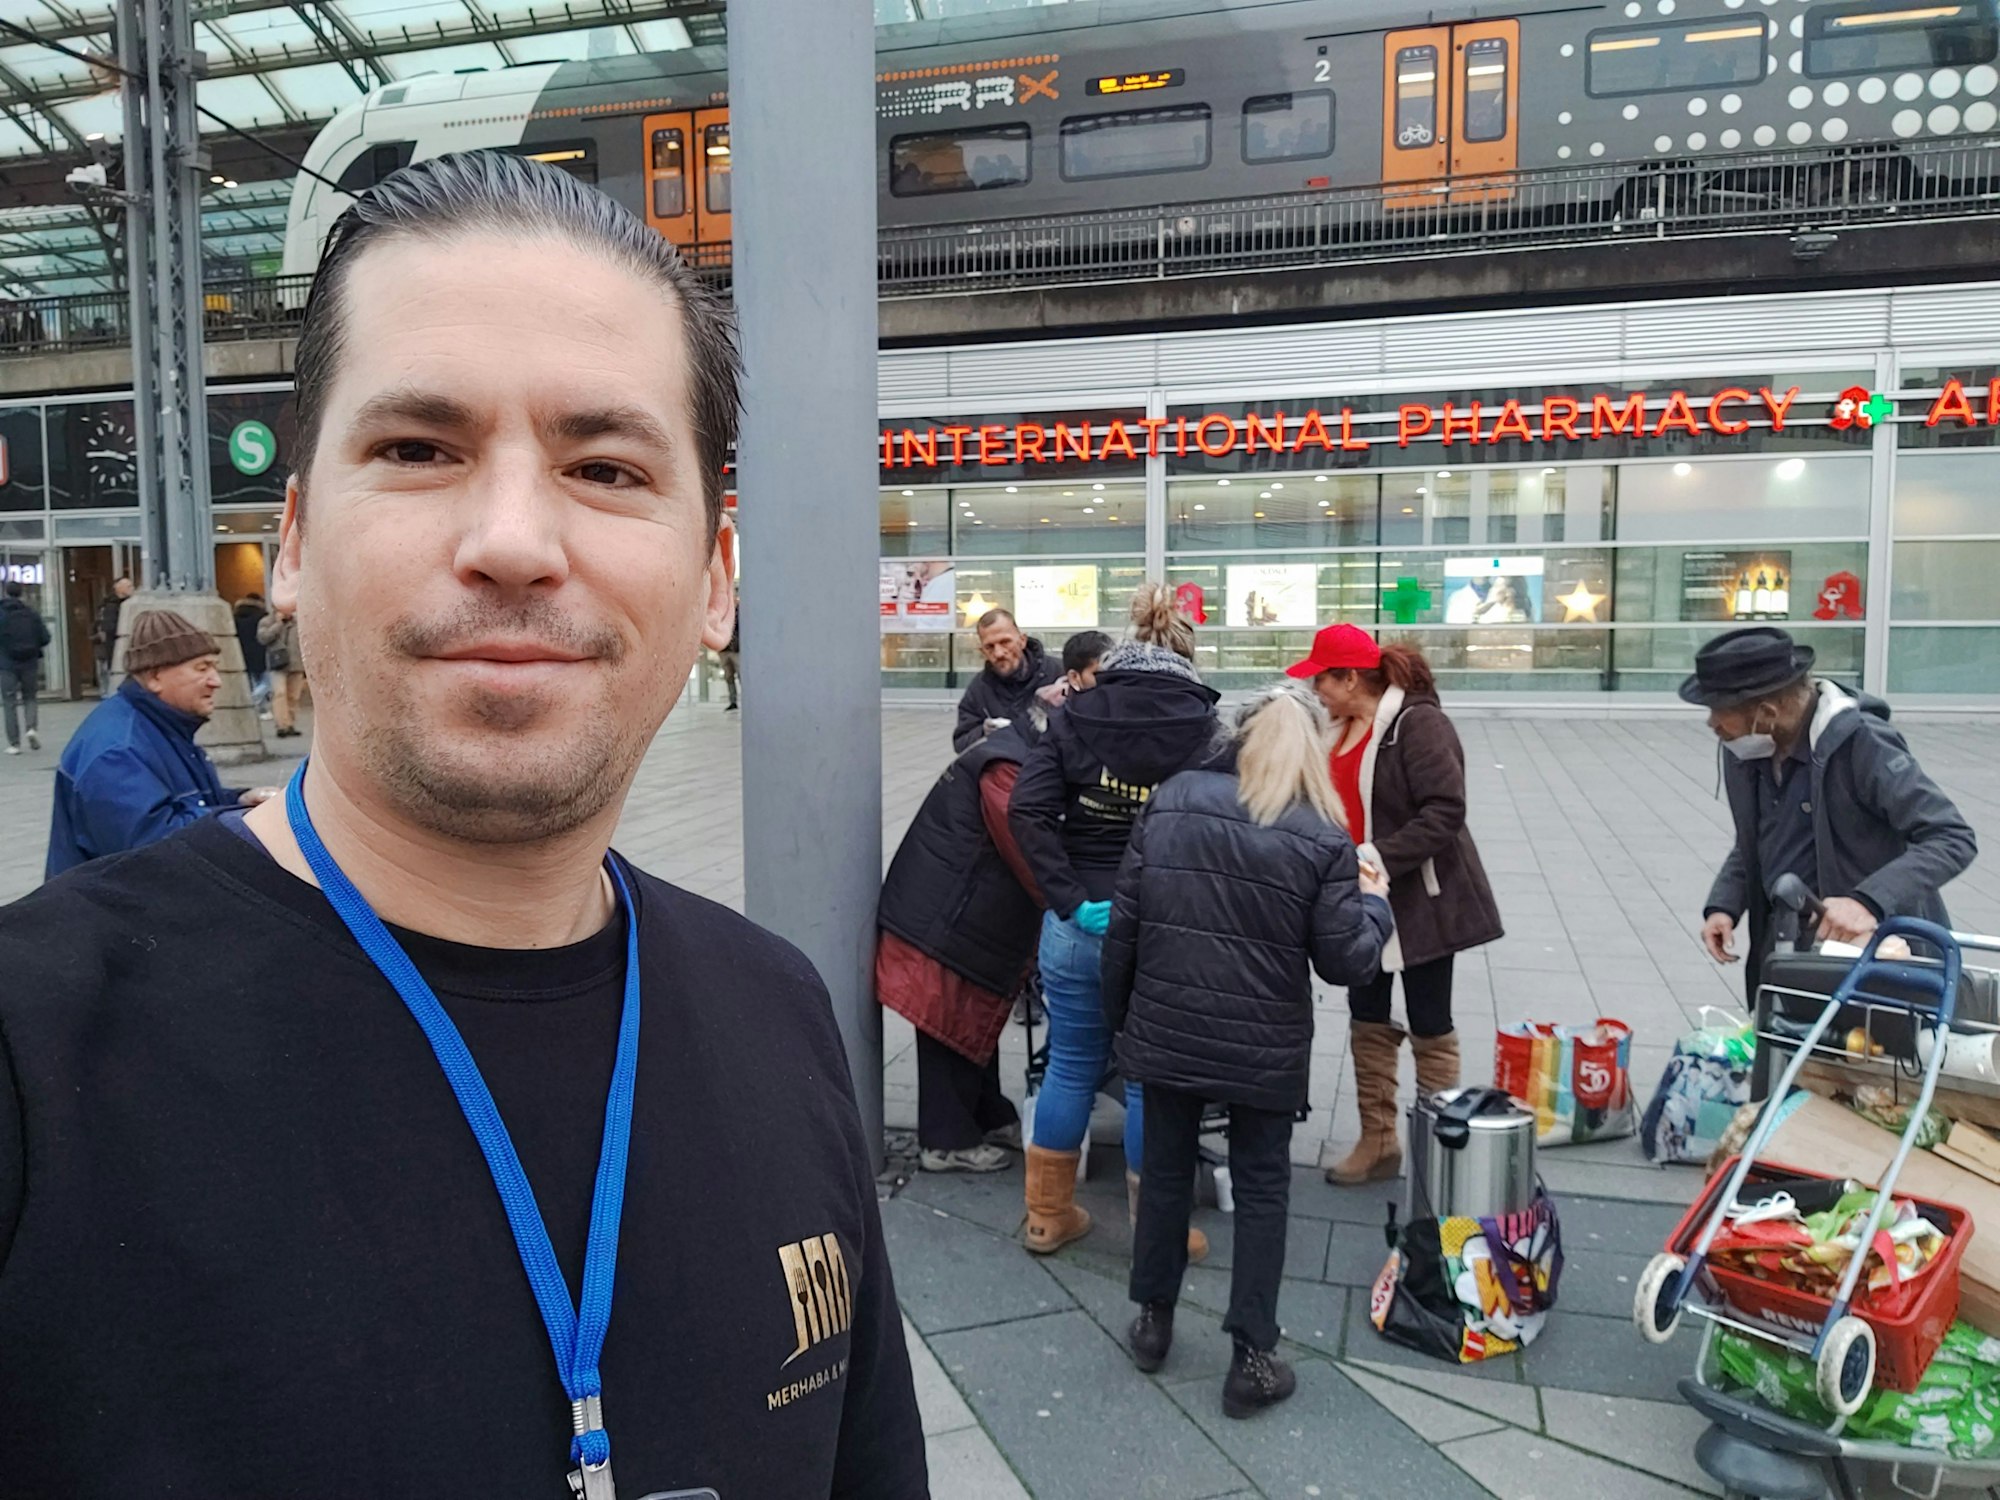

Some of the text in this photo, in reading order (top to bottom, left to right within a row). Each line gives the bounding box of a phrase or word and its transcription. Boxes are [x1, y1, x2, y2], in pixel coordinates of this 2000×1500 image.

[933, 69, 1060, 114] RRX
[1314, 59, 1331, 82] 2
[237, 426, 266, 470] S
[882, 386, 1801, 469] INTERNATIONAL PHARMACY
[1579, 1060, 1611, 1093] 50
[766, 1368, 830, 1412] MERHABA
[832, 1364, 839, 1380] &
